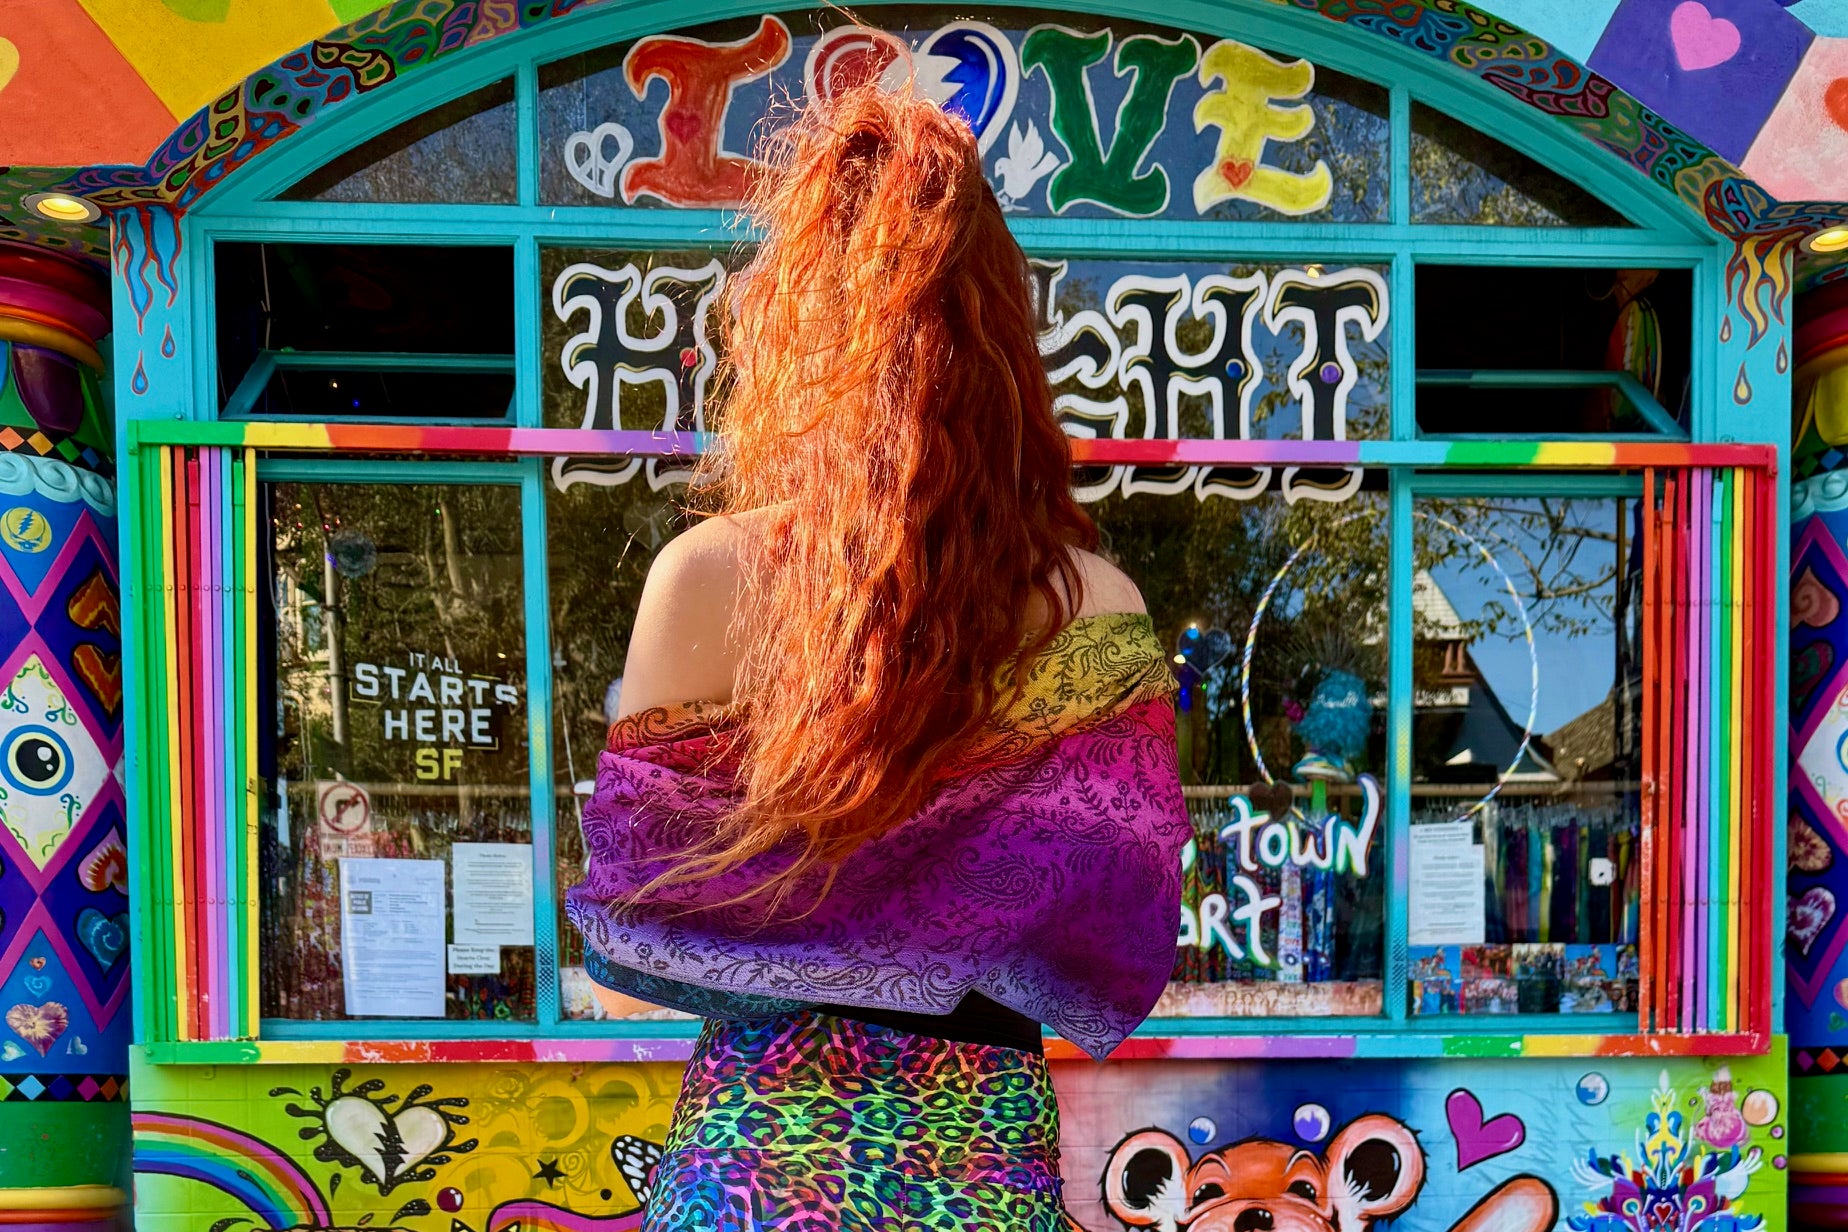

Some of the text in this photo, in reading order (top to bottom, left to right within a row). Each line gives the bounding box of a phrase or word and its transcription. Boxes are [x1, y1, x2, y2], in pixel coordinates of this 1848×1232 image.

[409, 652, 464, 675] IT ALL
[355, 662, 519, 706] STARTS
[384, 708, 493, 744] HERE
[415, 747, 464, 780] SF
